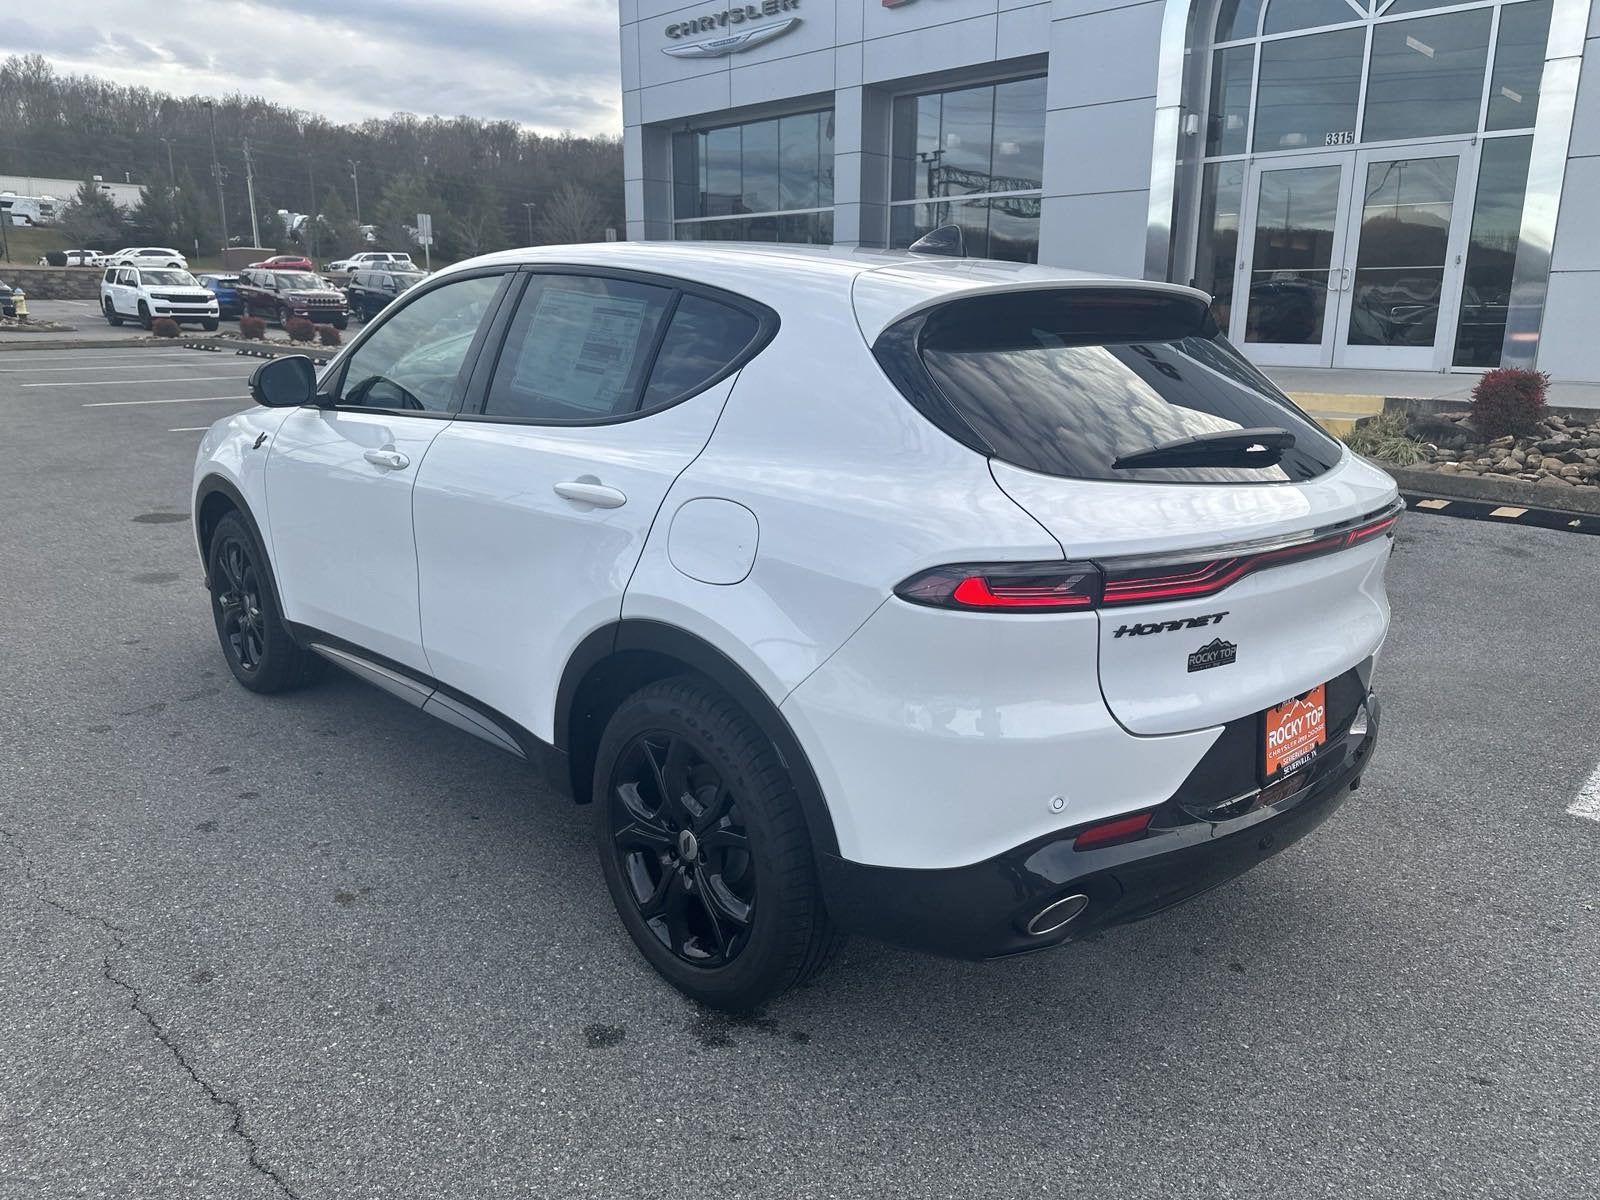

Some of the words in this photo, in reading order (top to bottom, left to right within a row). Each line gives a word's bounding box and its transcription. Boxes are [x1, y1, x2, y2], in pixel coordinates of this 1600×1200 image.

[1326, 132, 1353, 145] 3315
[1113, 611, 1230, 638] HORNET
[1189, 650, 1218, 665] ROCKY
[1220, 647, 1236, 659] TOP
[1269, 715, 1305, 748] ROCKY
[1305, 705, 1324, 729] TOP
[1268, 740, 1297, 758] CHRYSLER
